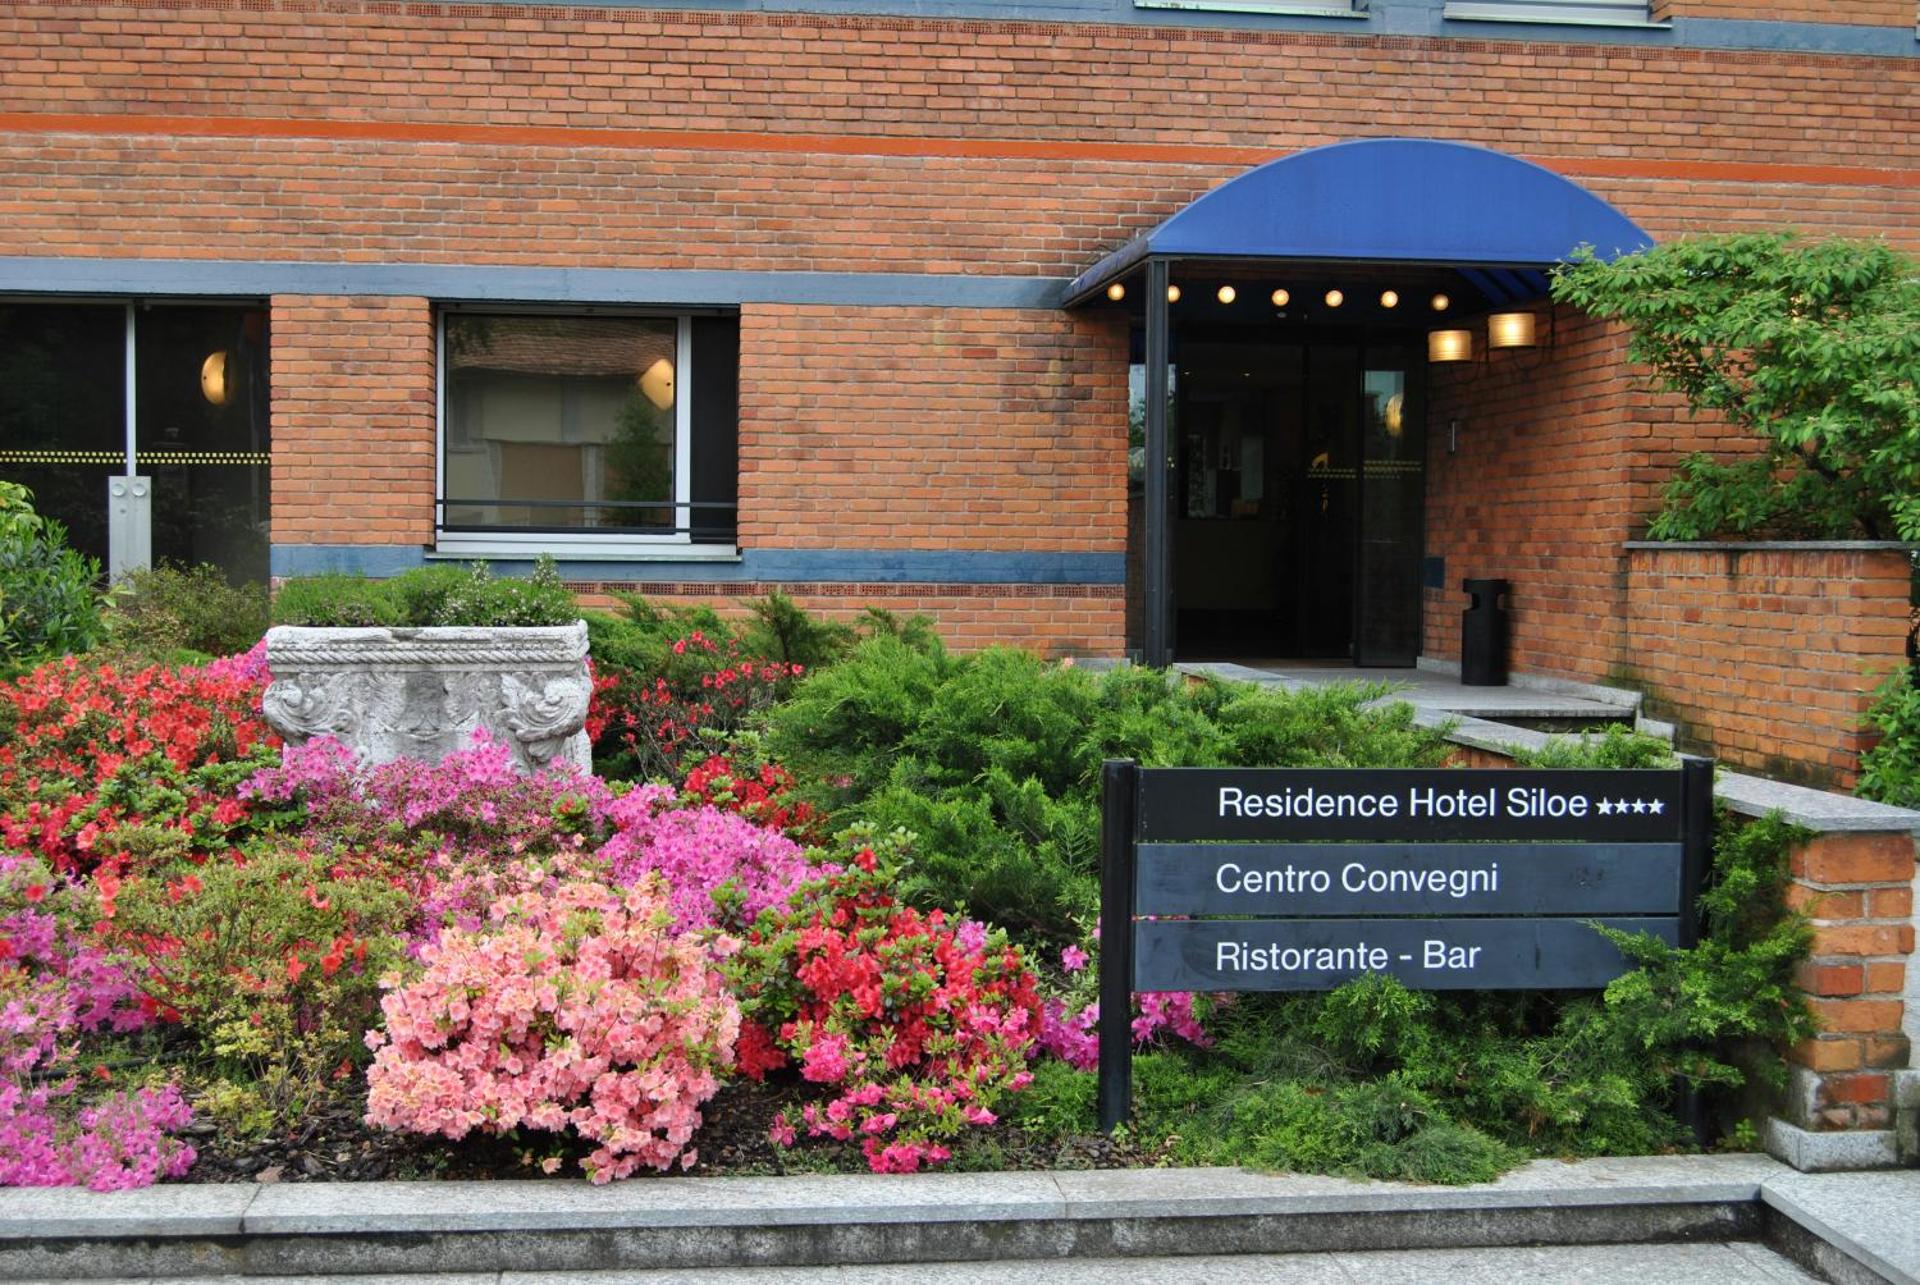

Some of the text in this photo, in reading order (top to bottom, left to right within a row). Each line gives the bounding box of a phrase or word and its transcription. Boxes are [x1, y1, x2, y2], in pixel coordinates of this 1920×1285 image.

[1219, 787, 1588, 817] Residence Hotel Siloe
[1216, 862, 1497, 898] Centro Convegni
[1216, 941, 1389, 971] Ristorante
[1423, 940, 1482, 969] Bar
